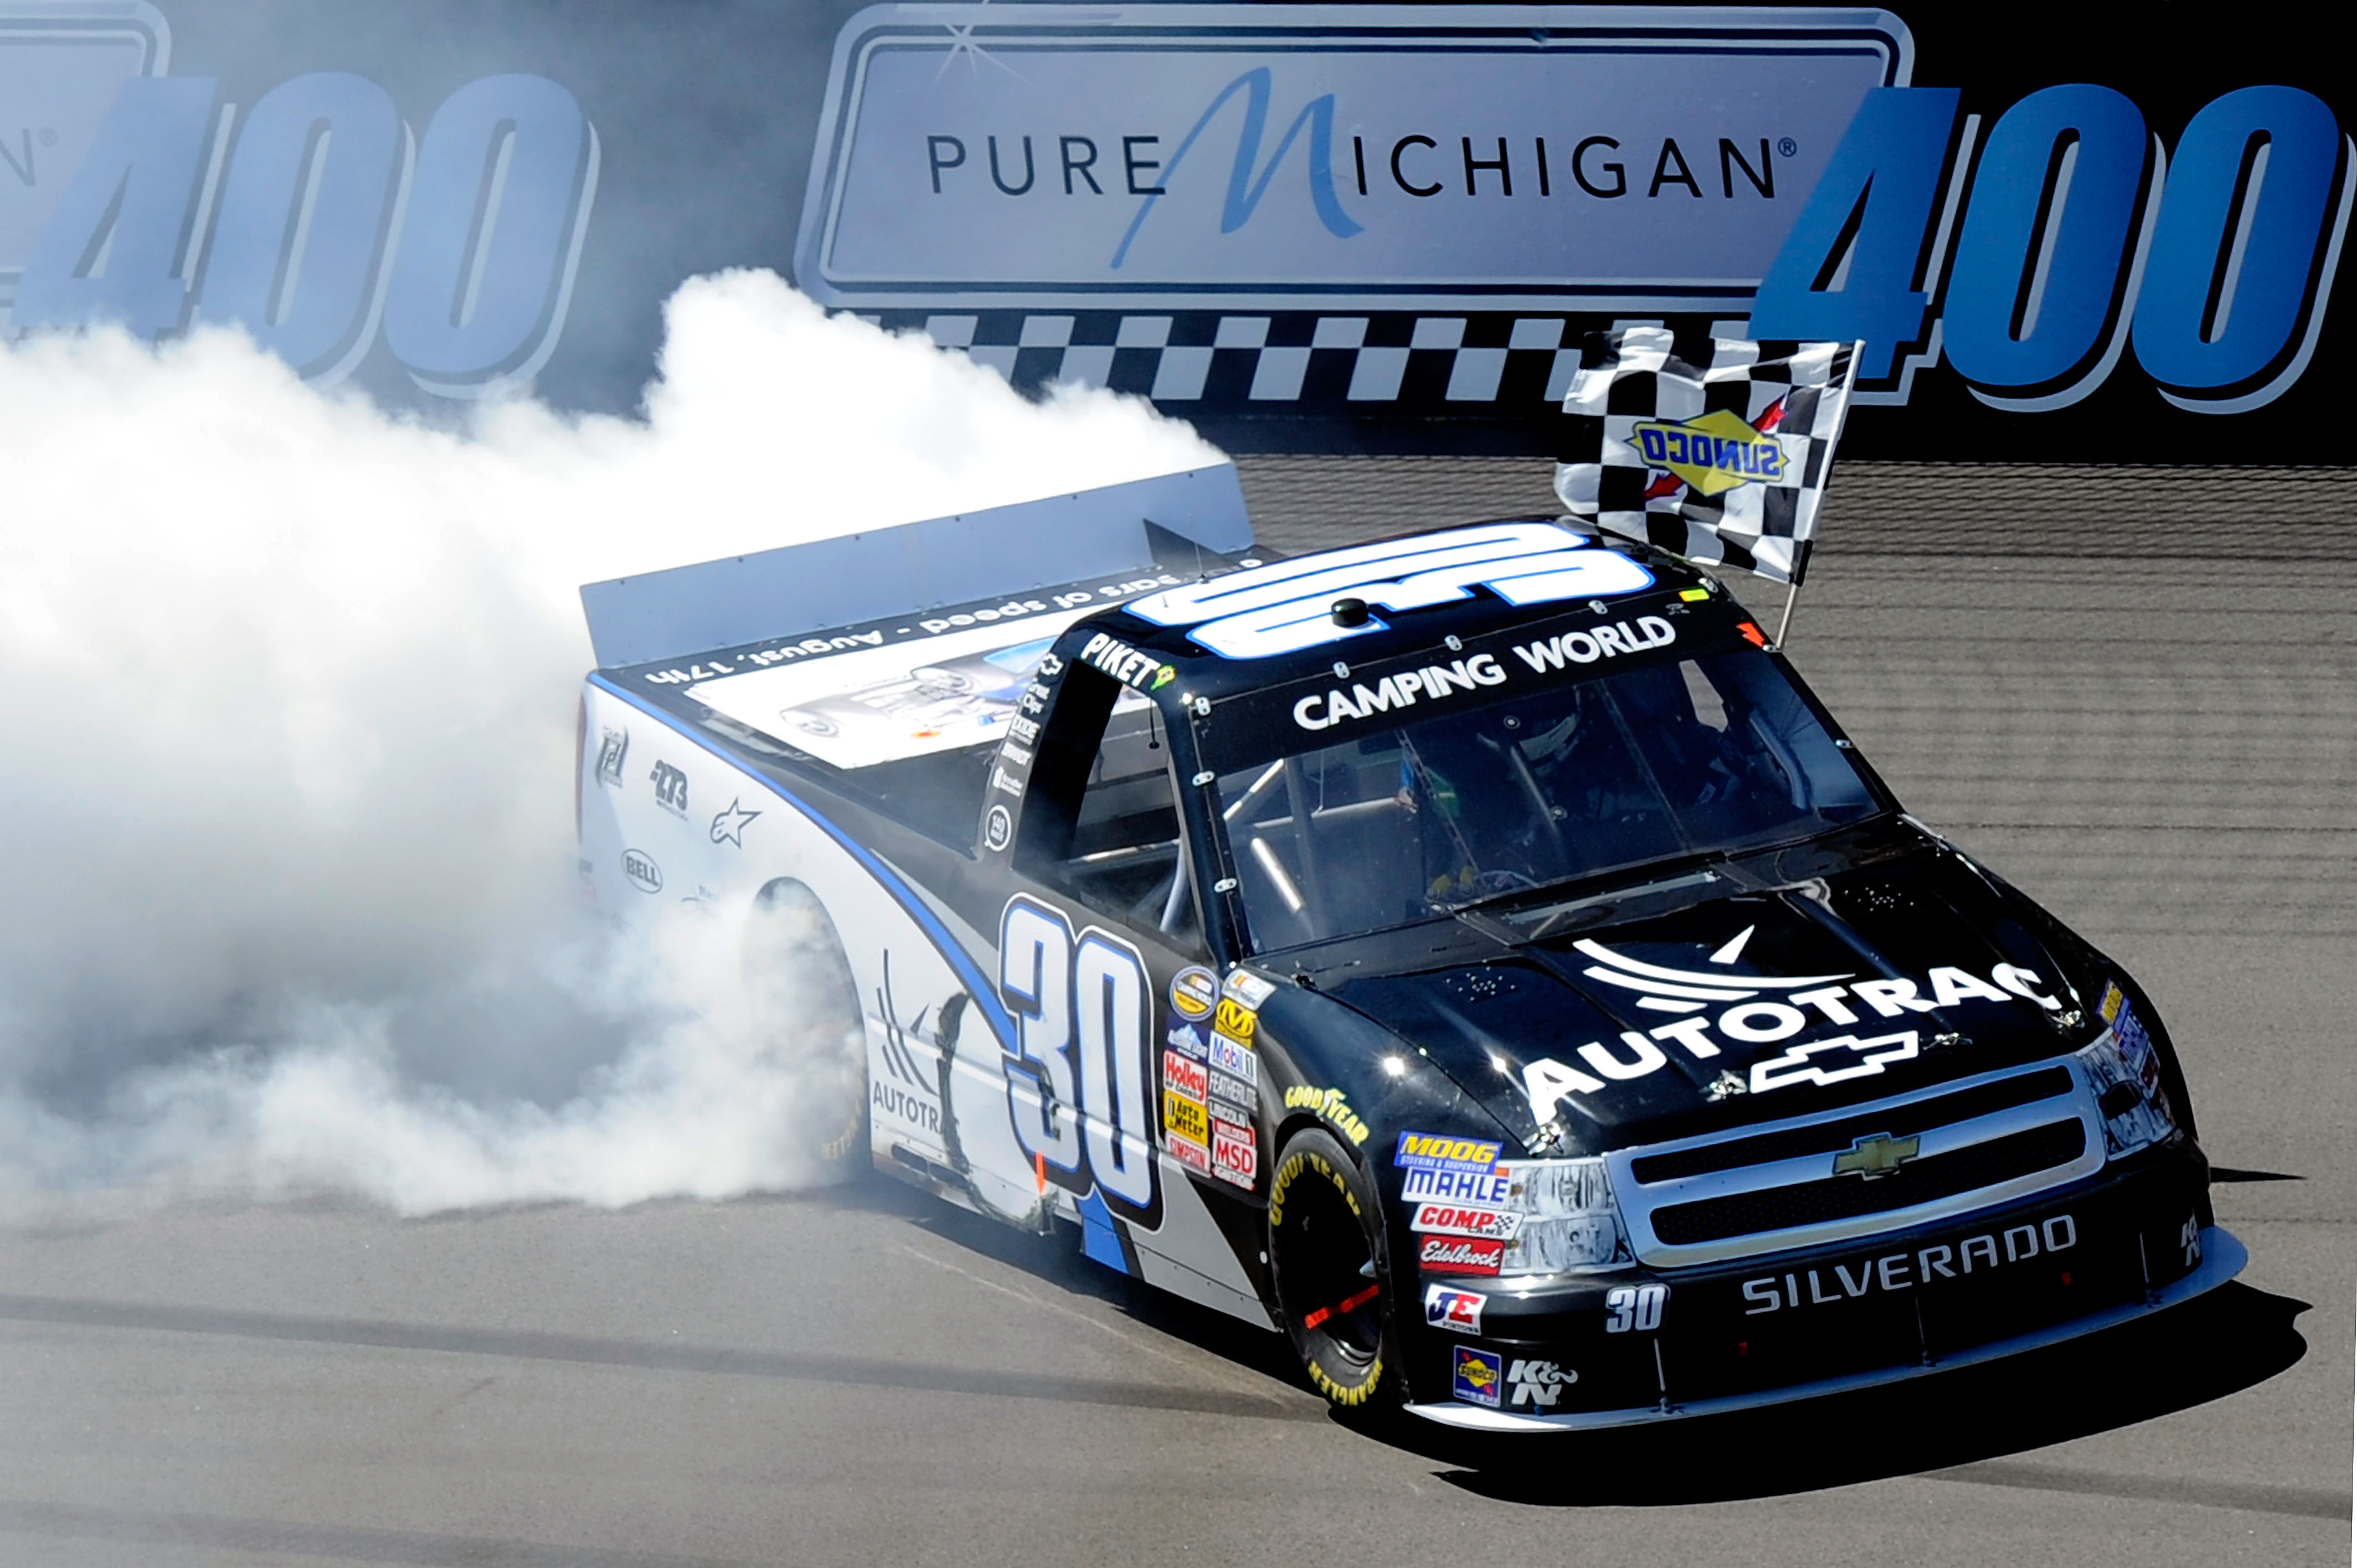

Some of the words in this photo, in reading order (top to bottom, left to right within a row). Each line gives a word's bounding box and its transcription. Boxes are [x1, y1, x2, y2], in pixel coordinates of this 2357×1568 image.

[927, 135, 1166, 195] PURE
[10, 71, 595, 390] 400
[1746, 83, 2348, 399] 400
[1080, 632, 1161, 687] PIKET
[1293, 653, 1506, 730] CAMPING
[1512, 615, 1676, 673] WORLD
[625, 855, 660, 887] BELL
[1000, 894, 1163, 1230] 30
[1522, 962, 2062, 1126] AUTOTRAC
[1166, 1053, 1205, 1102] Holley
[873, 1081, 942, 1134] AUTOTR
[1216, 1139, 1253, 1174] MSD
[1399, 1134, 1499, 1164] MOOG
[1407, 1169, 1509, 1203] MAHLE
[1419, 1206, 1496, 1229] COMP
[1420, 1240, 1501, 1268] Edelbrock
[1742, 1214, 2077, 1316] SILVERADO
[1428, 1292, 1481, 1324] JE
[1606, 1284, 1669, 1333] 30
